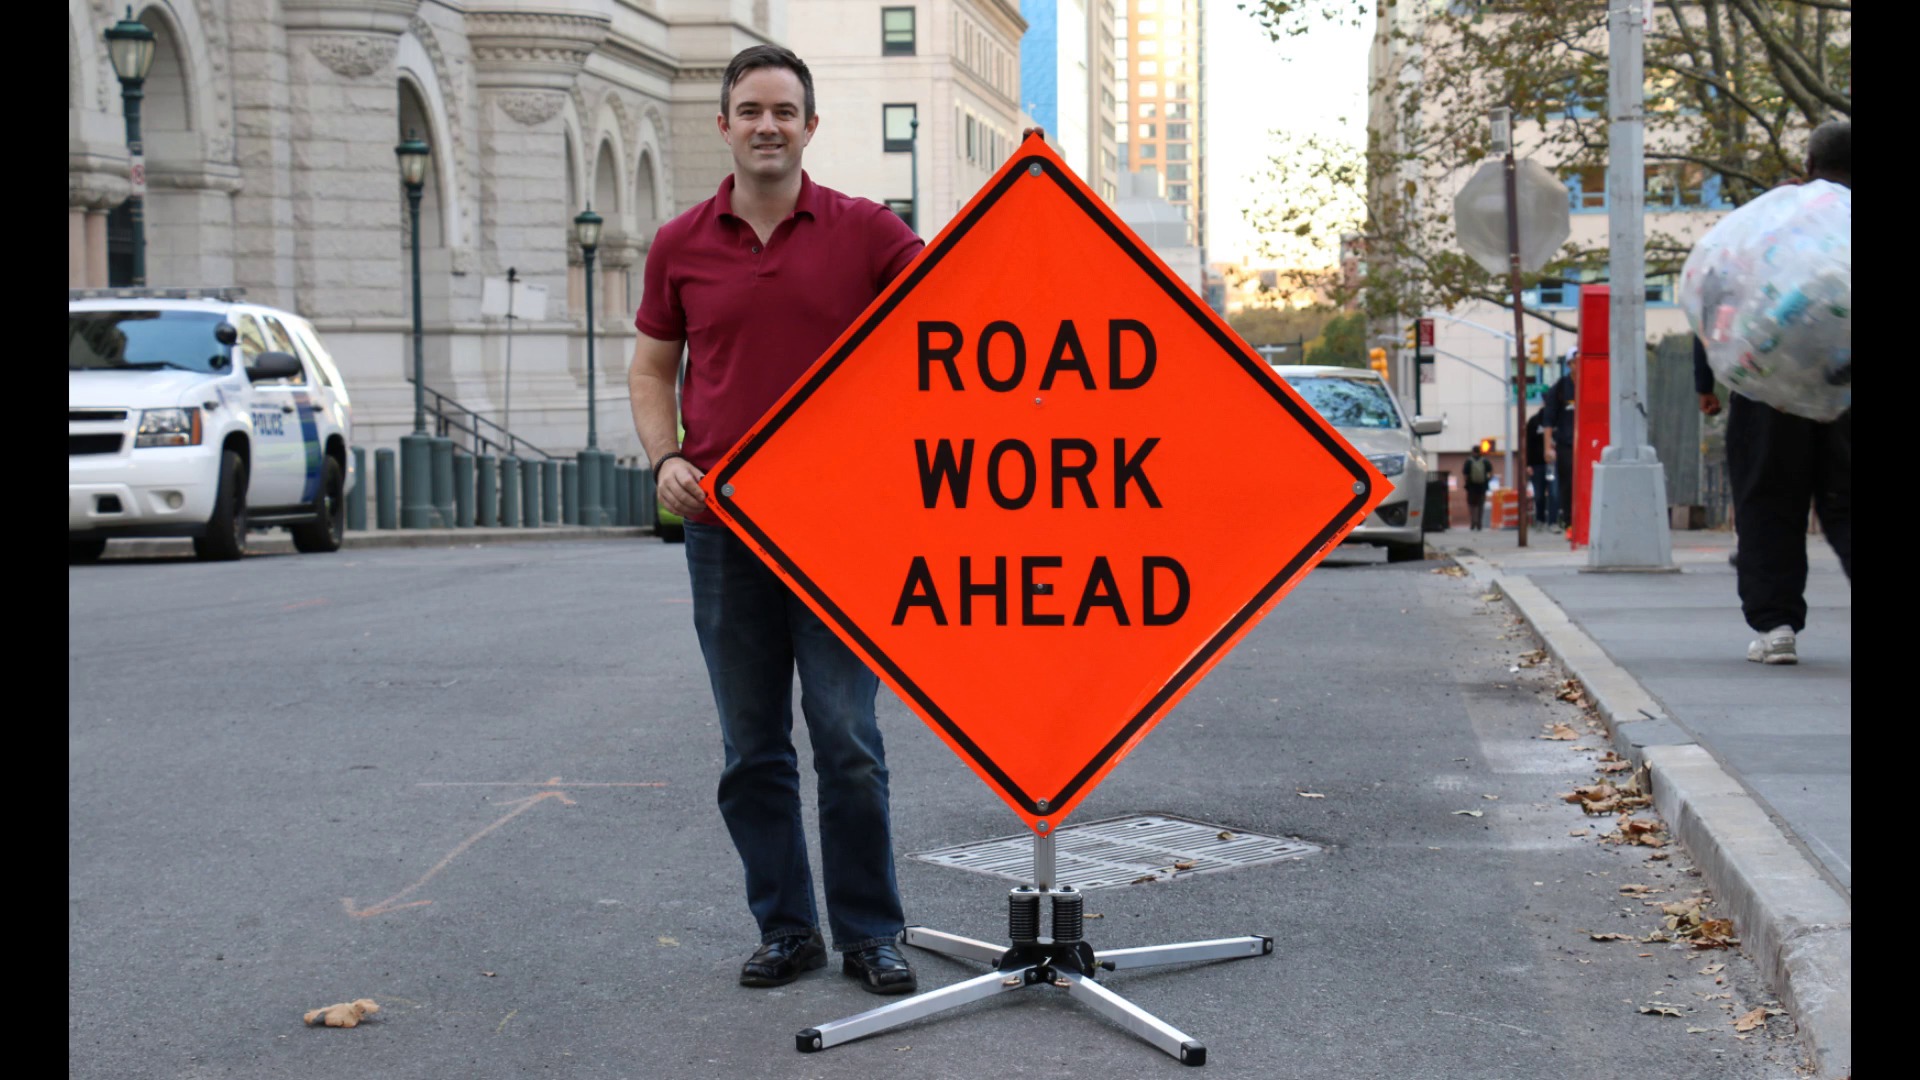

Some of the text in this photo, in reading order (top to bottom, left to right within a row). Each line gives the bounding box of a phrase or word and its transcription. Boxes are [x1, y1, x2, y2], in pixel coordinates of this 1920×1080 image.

[917, 319, 1158, 393] ROAD
[251, 412, 284, 436] POLICE
[914, 437, 1163, 511] WORK
[891, 555, 1191, 627] AHEAD
